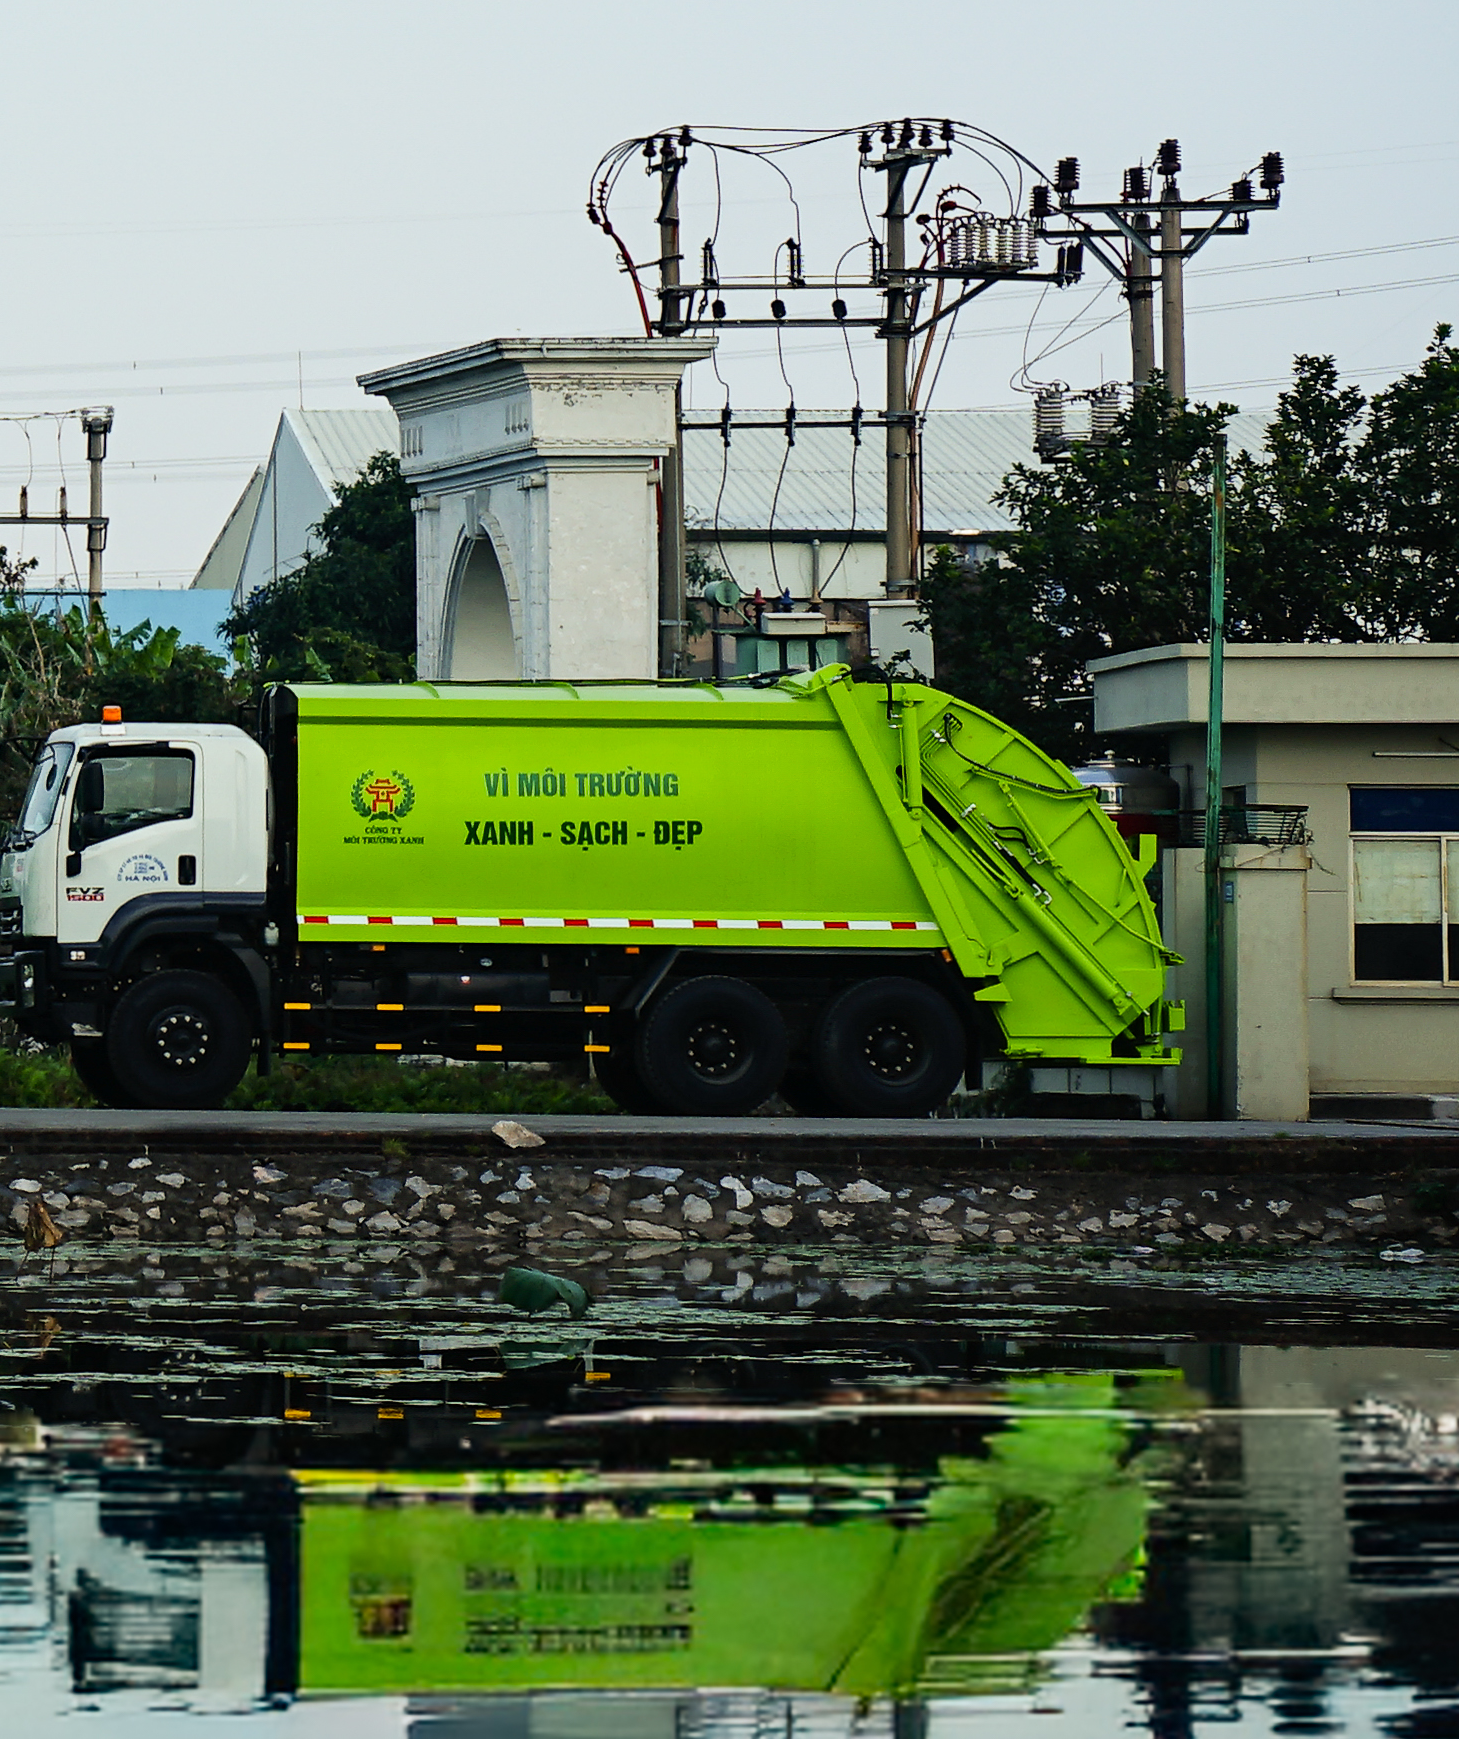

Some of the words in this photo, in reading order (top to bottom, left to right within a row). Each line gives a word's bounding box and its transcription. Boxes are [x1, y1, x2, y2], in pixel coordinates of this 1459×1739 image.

[485, 768, 509, 797] VÌ
[519, 768, 566, 797] MÔI
[575, 766, 679, 797] TRƯỜNG
[399, 836, 425, 844] XANH
[464, 821, 533, 845] XANH
[561, 821, 627, 851] SẠCH
[654, 820, 703, 851] ĐẸP
